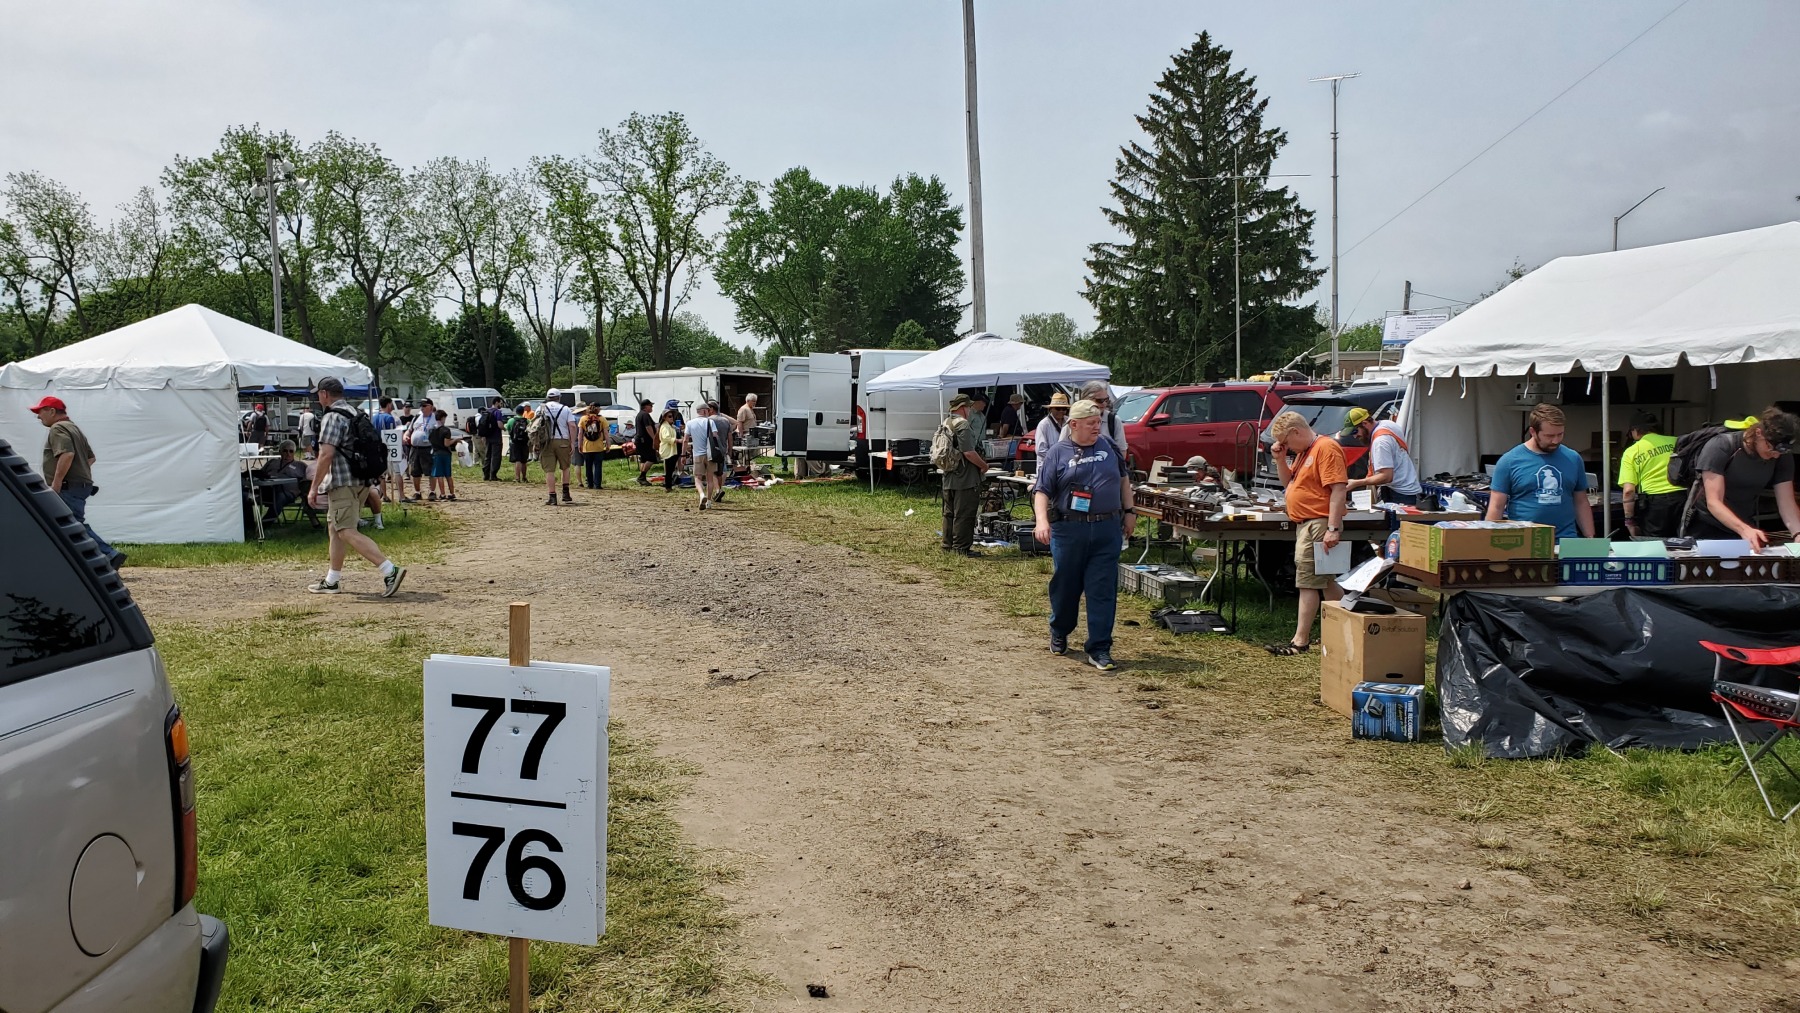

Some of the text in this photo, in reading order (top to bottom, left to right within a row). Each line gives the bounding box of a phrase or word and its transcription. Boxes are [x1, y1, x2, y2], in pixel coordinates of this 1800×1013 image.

[384, 433, 397, 443] 79
[1633, 443, 1674, 466] GOT RADIOS
[1368, 622, 1381, 636] hp
[451, 693, 567, 781] 77
[452, 821, 567, 912] 76
